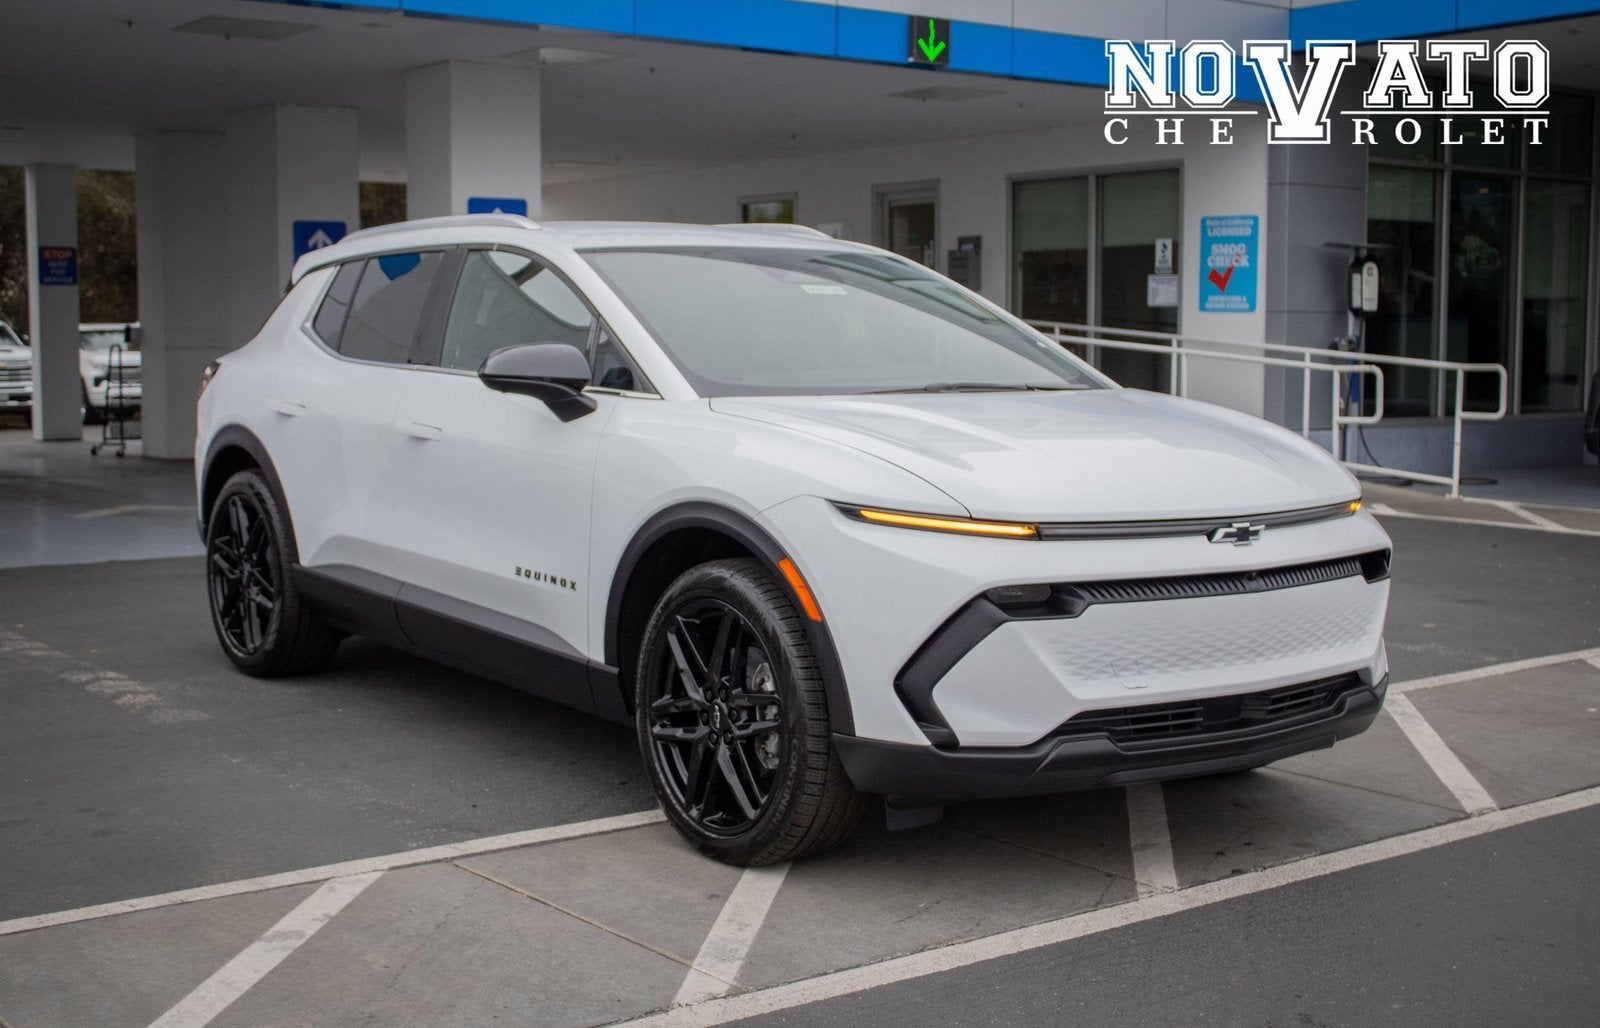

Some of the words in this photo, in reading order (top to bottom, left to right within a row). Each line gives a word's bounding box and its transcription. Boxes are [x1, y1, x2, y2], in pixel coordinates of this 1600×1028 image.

[1207, 226, 1252, 237] LICENSED
[43, 249, 73, 260] STOP
[1211, 243, 1246, 255] SMOG
[1206, 254, 1250, 268] CHECK
[515, 566, 577, 591] EQUINOX
